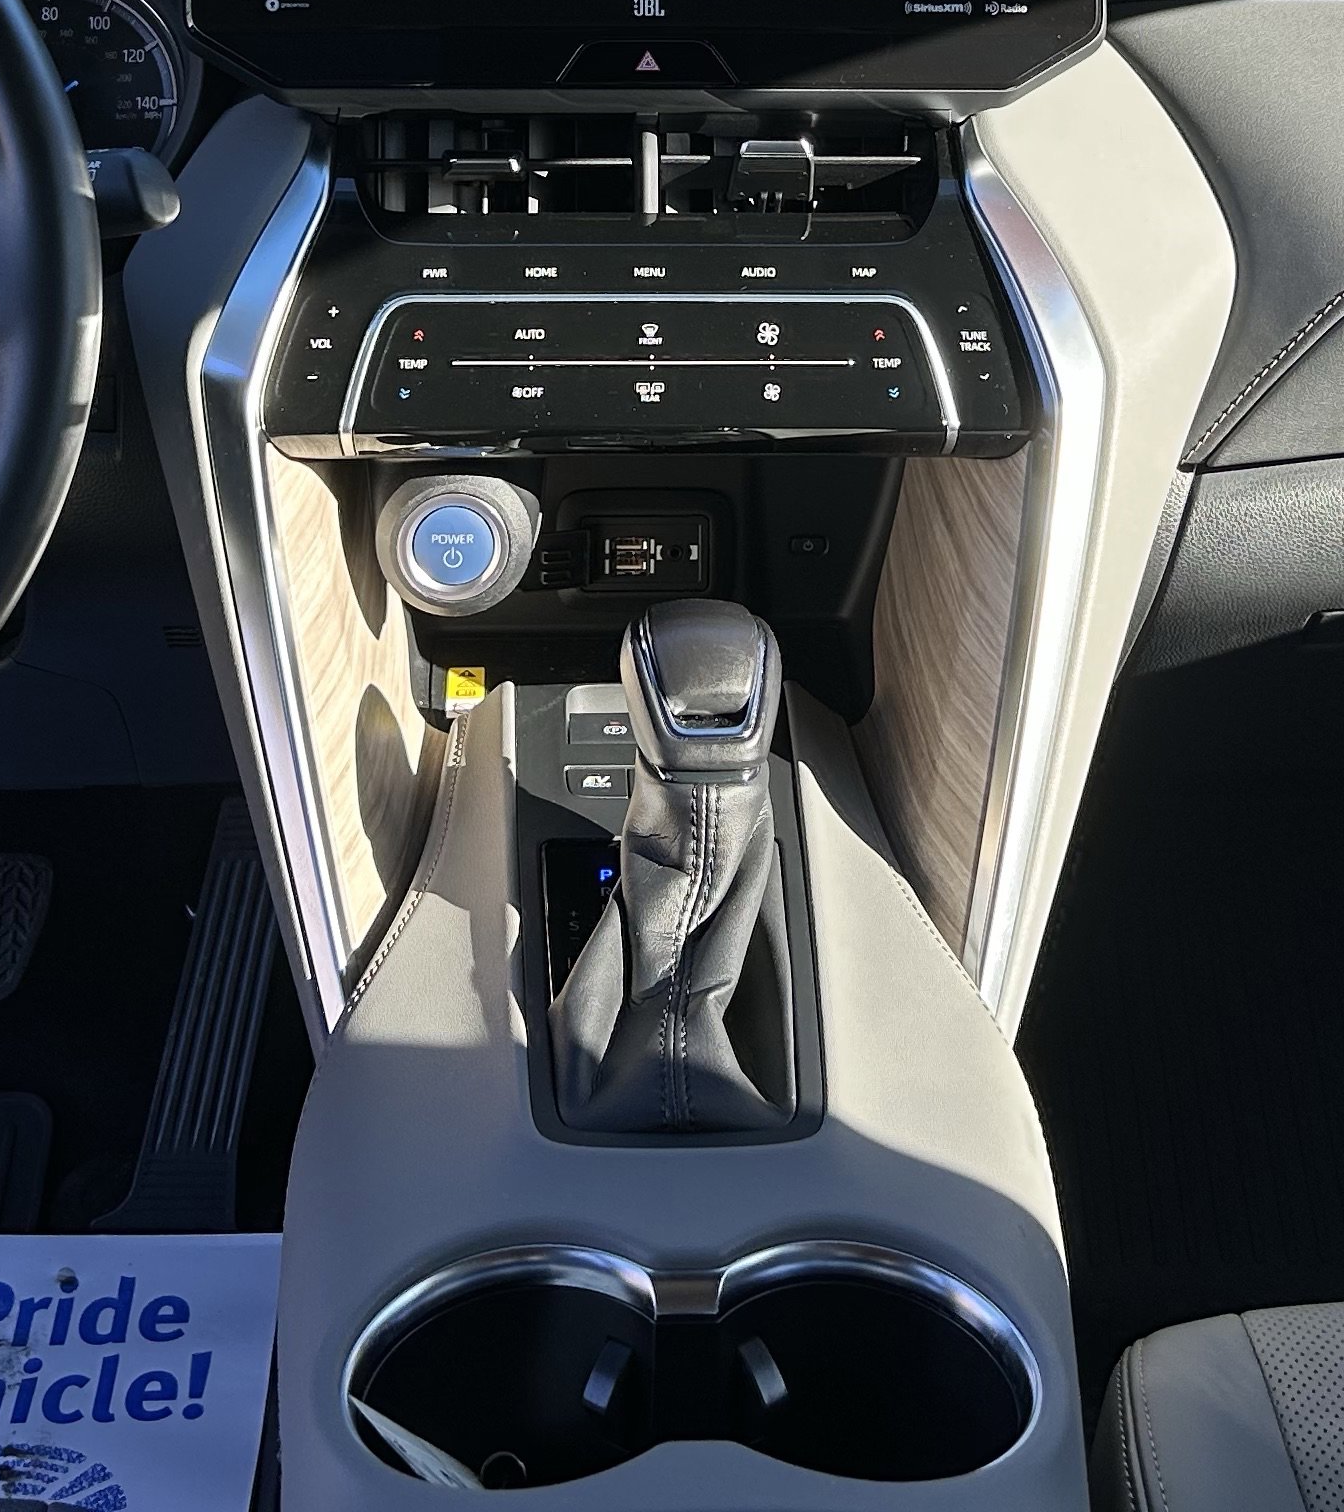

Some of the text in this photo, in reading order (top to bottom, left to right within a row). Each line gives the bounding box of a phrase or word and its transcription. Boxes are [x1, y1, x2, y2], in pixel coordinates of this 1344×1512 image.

[913, 3, 965, 13] SiriusXM
[1000, 3, 1028, 13] Radio
[41, 7, 59, 21] 80
[89, 16, 111, 31] 100
[122, 48, 145, 64] 120
[135, 95, 159, 111] 140
[422, 268, 448, 279] PWR
[524, 267, 558, 278] HOME
[633, 267, 666, 278] MENU
[740, 267, 777, 278] AUDIO
[851, 267, 877, 278] MAP
[514, 328, 546, 340] AUTO
[960, 330, 988, 341] TUNE
[309, 338, 333, 349] VOL
[638, 337, 663, 345] FRONT
[959, 341, 992, 352] TRACK
[398, 358, 428, 370] TEMP
[872, 357, 902, 369] TEMP
[523, 387, 545, 398] OFF
[640, 394, 661, 403] REAR
[431, 533, 475, 545] POWER
[599, 869, 613, 881] P
